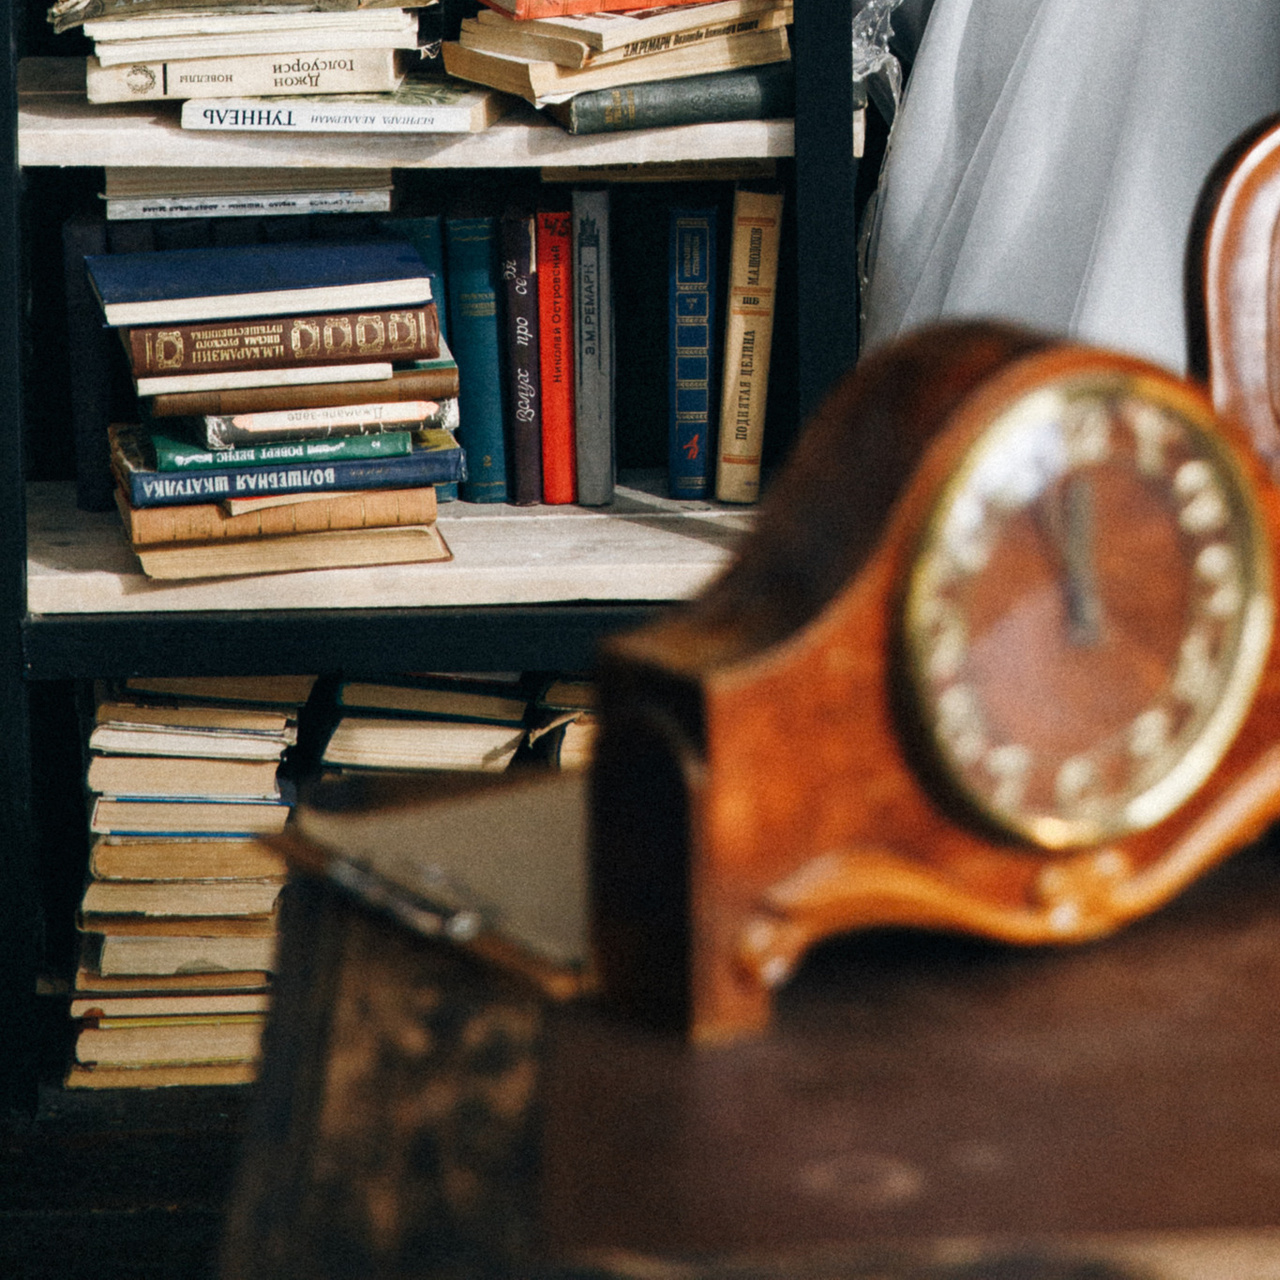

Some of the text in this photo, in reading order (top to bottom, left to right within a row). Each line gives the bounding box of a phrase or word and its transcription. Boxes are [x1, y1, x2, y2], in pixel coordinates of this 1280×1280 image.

[622, 34, 672, 58] Э.М.РЕМАРК
[272, 57, 355, 76] Голсуорси
[179, 73, 233, 83] НОВЕЛЛЫ
[273, 71, 320, 88] Джон
[202, 108, 297, 127] ТУННЕЛЬ
[310, 114, 376, 125] КЕЛЛЕРМАН
[552, 243, 562, 325] Островский
[584, 262, 596, 356] Э.М.РЕМАРК
[195, 334, 282, 349] ПИСЬМА РУССКОГО
[515, 315, 534, 347] про
[553, 326, 564, 384] Николай
[734, 329, 757, 442] ПОДНЯТАЯ ЦЕЛИНА
[216, 443, 304, 464] РОБЕРТ БЕРНС
[142, 466, 336, 498] ВОЛШЕБНАЯ ШКАТУЛКА
